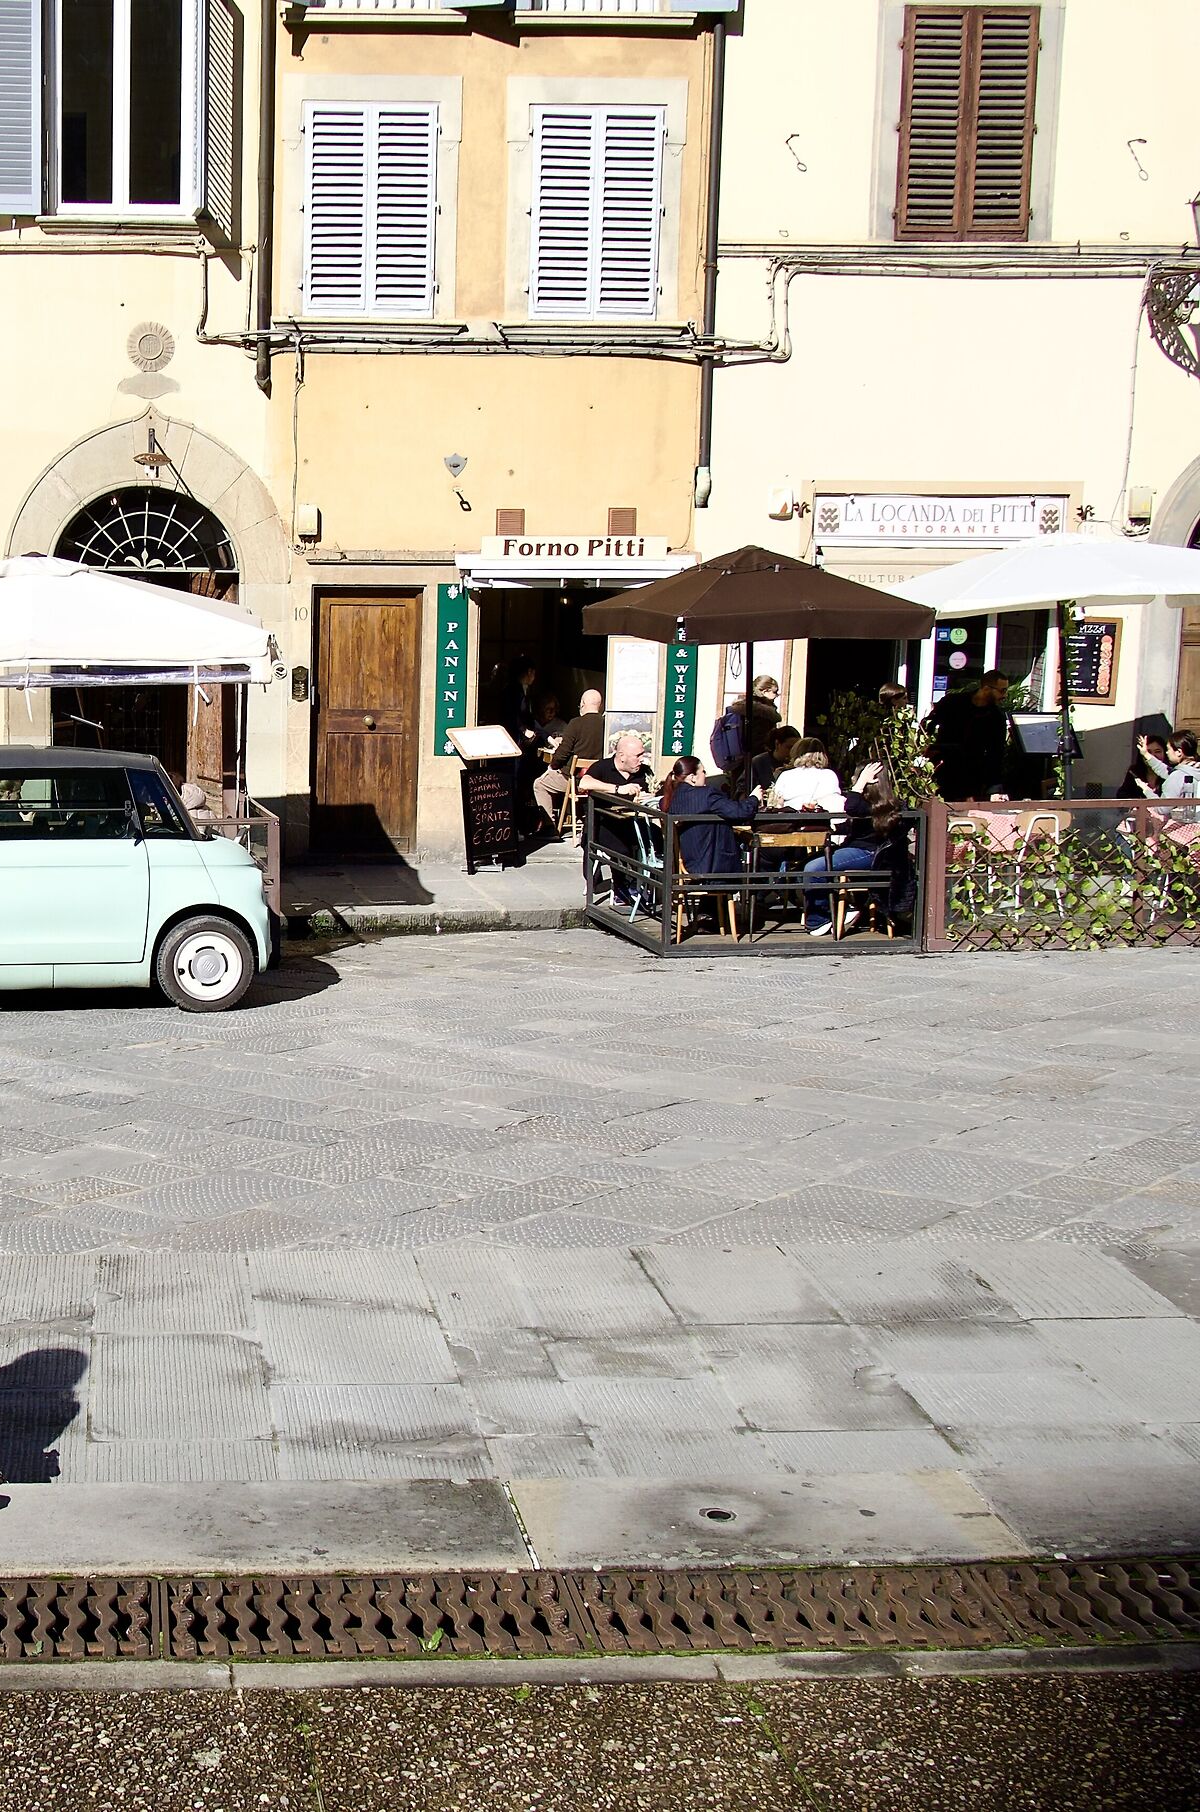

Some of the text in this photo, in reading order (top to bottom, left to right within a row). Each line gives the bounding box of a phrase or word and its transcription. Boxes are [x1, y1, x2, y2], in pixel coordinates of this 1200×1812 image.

[871, 503, 955, 522] LOCANDA
[990, 503, 1036, 523] PITTI
[878, 525, 1000, 534] RISTORANTE
[503, 538, 645, 557] Forno Pitti
[848, 574, 915, 583] CULTUR
[294, 607, 308, 621] 10
[443, 622, 459, 719] PANINI
[673, 665, 689, 703] WINE
[672, 710, 686, 738] BAR
[475, 811, 511, 825] SPRITZ
